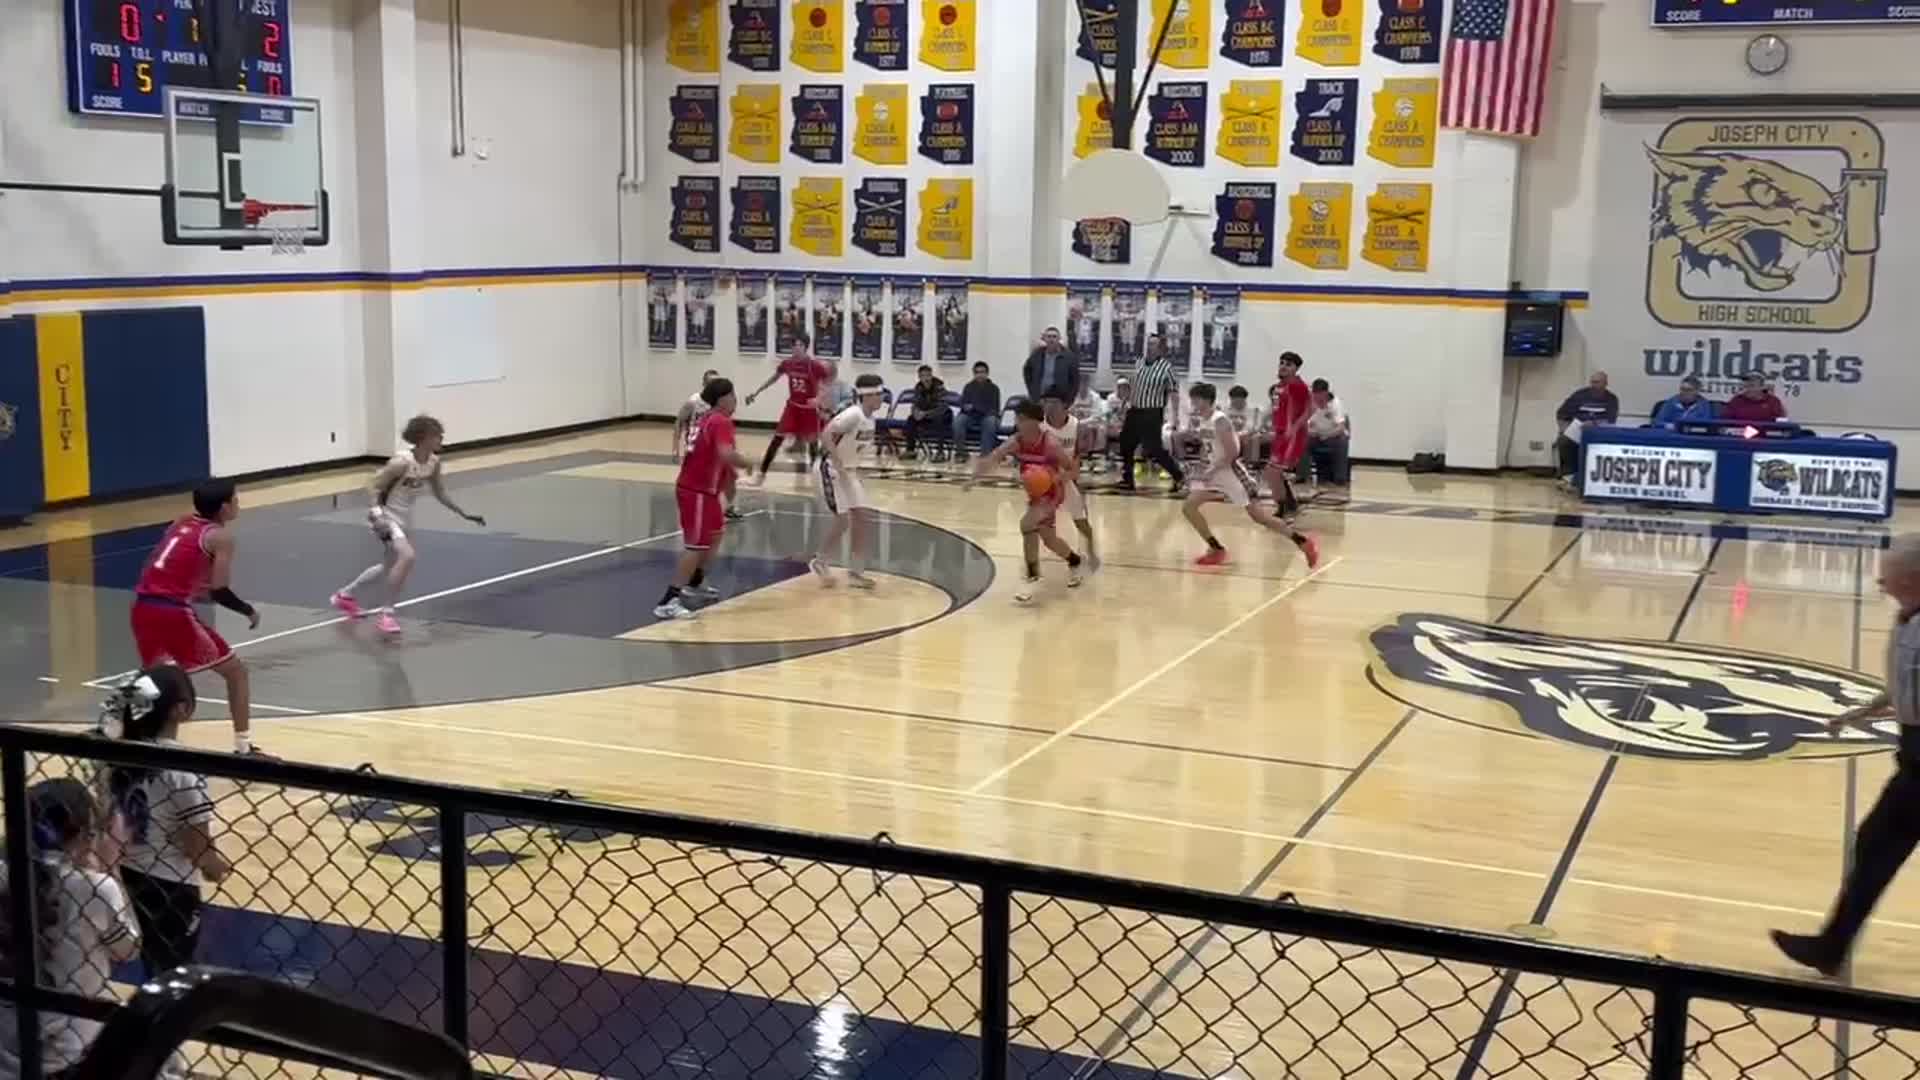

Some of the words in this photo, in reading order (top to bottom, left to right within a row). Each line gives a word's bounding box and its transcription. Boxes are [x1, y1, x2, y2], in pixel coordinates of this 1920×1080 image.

[121, 4, 139, 41] 0
[1773, 8, 1813, 19] MATCH
[263, 22, 280, 58] 2
[137, 63, 152, 92] 5
[1707, 125, 1779, 143] JOSEPH
[1785, 125, 1830, 141] CITY
[1699, 305, 1738, 323] HIGH
[1745, 306, 1816, 325] SCHOOL
[1643, 338, 1863, 384] wildcats
[55, 364, 71, 451] CITY
[1590, 456, 1661, 486] JOSEPH
[1664, 459, 1713, 490] CITY
[1799, 467, 1882, 499] WILDCATS
[154, 537, 178, 569] 1
